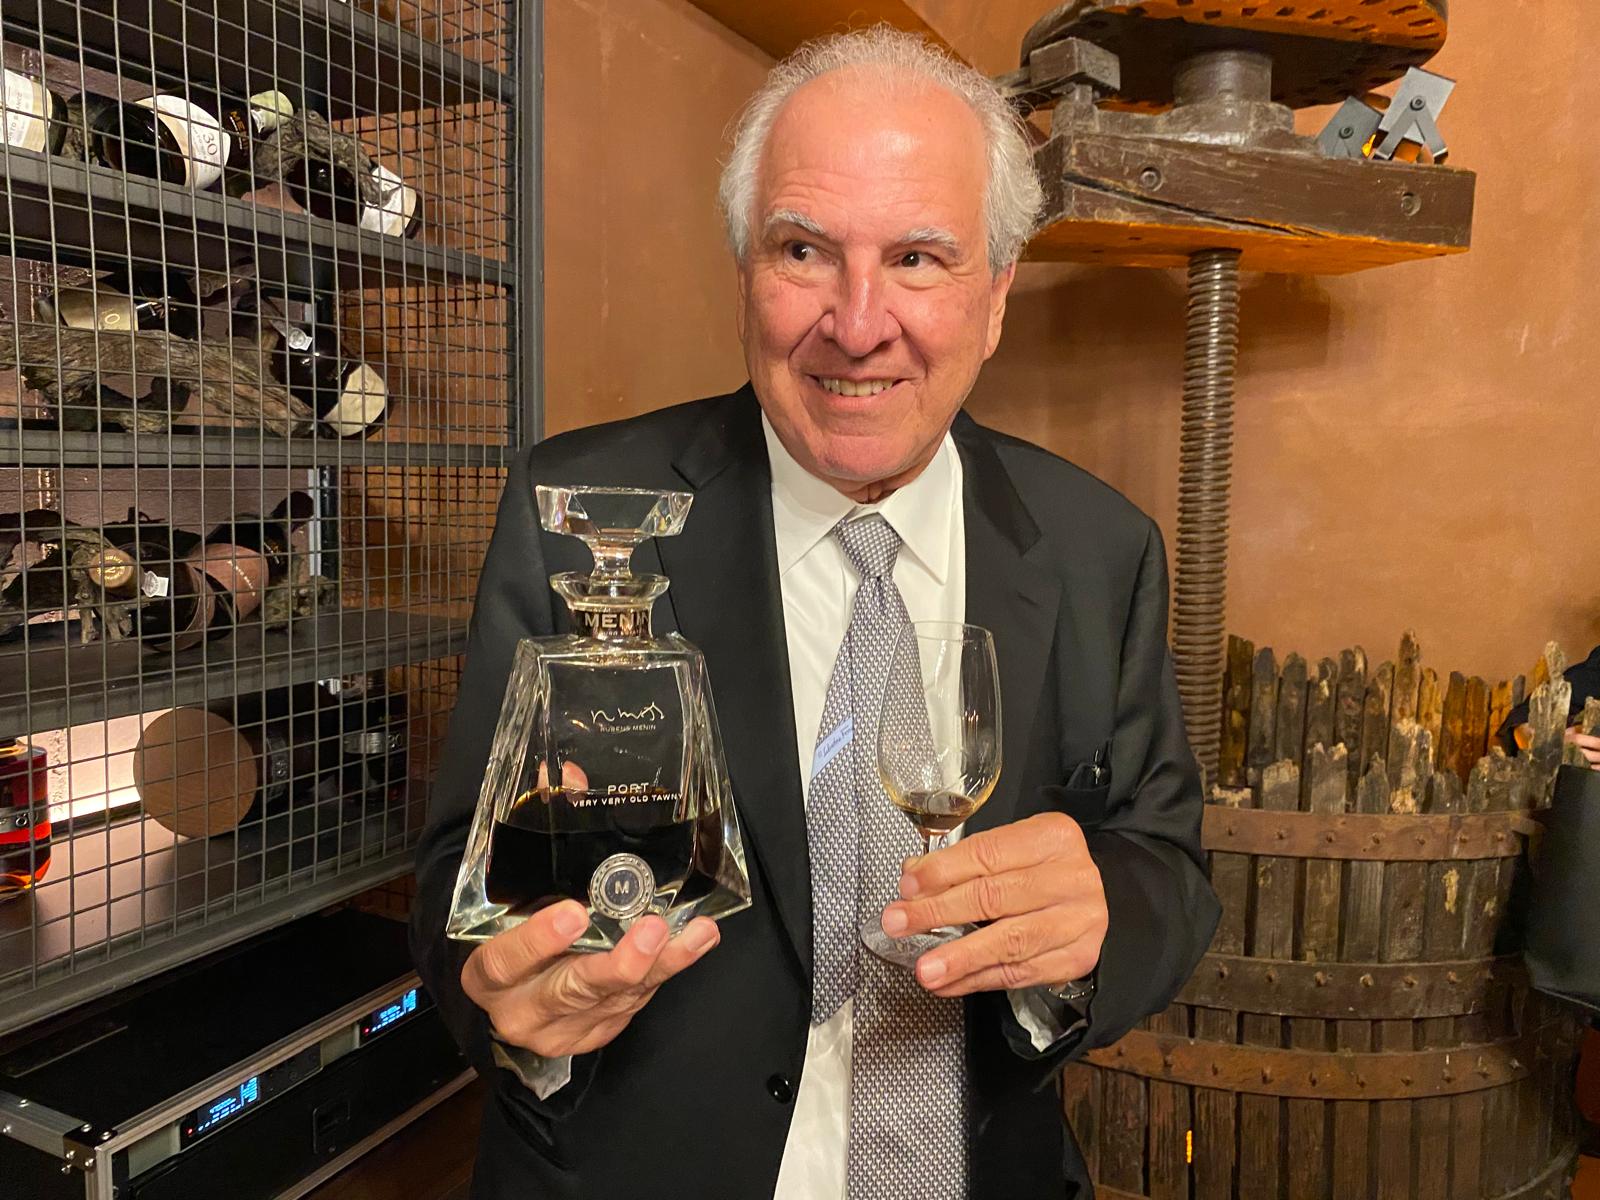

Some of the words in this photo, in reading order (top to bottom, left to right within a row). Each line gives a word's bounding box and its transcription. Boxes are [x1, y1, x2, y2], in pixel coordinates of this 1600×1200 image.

[202, 132, 218, 156] 30
[584, 610, 649, 629] MENIN
[632, 724, 656, 732] MENIN
[607, 782, 650, 795] PORT
[573, 799, 598, 808] VERY
[601, 797, 626, 806] VERY
[630, 795, 648, 804] OLD
[651, 792, 683, 802] TAWNY
[614, 880, 630, 895] M
